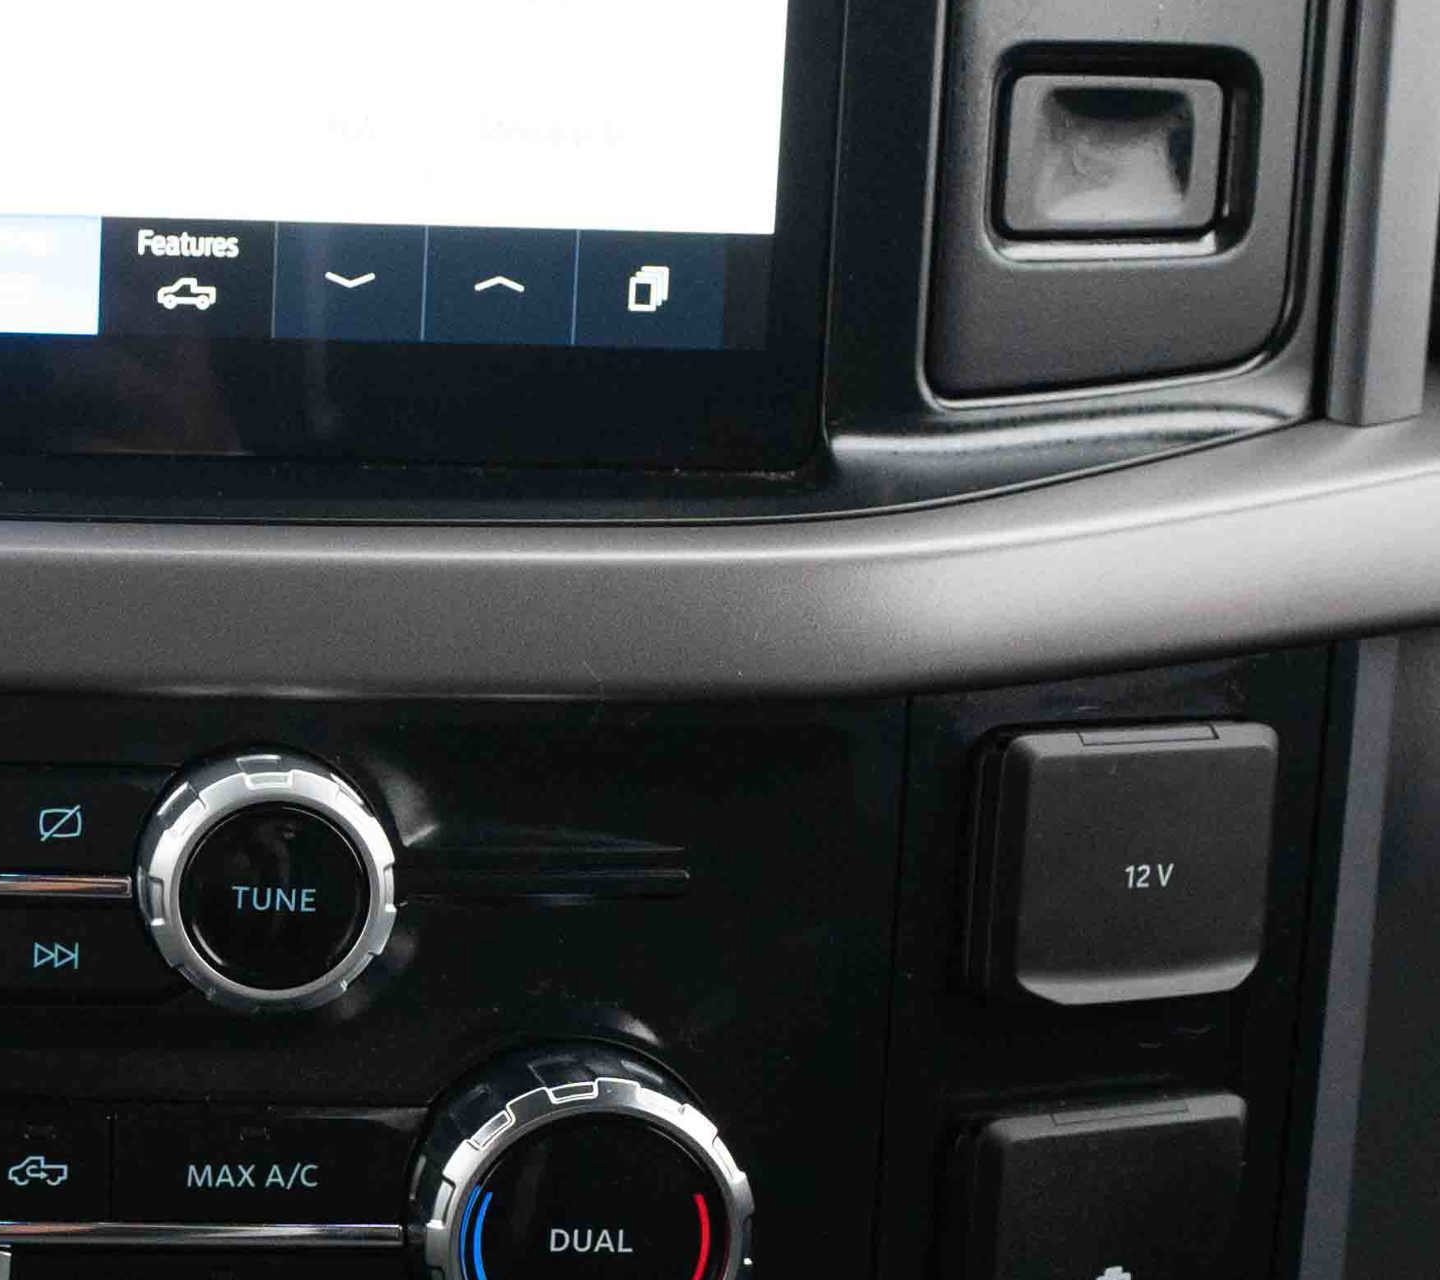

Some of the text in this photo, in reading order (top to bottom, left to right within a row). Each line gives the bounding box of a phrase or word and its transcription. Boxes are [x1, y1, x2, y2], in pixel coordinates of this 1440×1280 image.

[136, 227, 241, 259] Features
[1124, 862, 1175, 890] 12 V
[231, 884, 318, 913] TUNE
[186, 1162, 319, 1190] MAX A/C
[548, 1228, 635, 1254] DUAL
